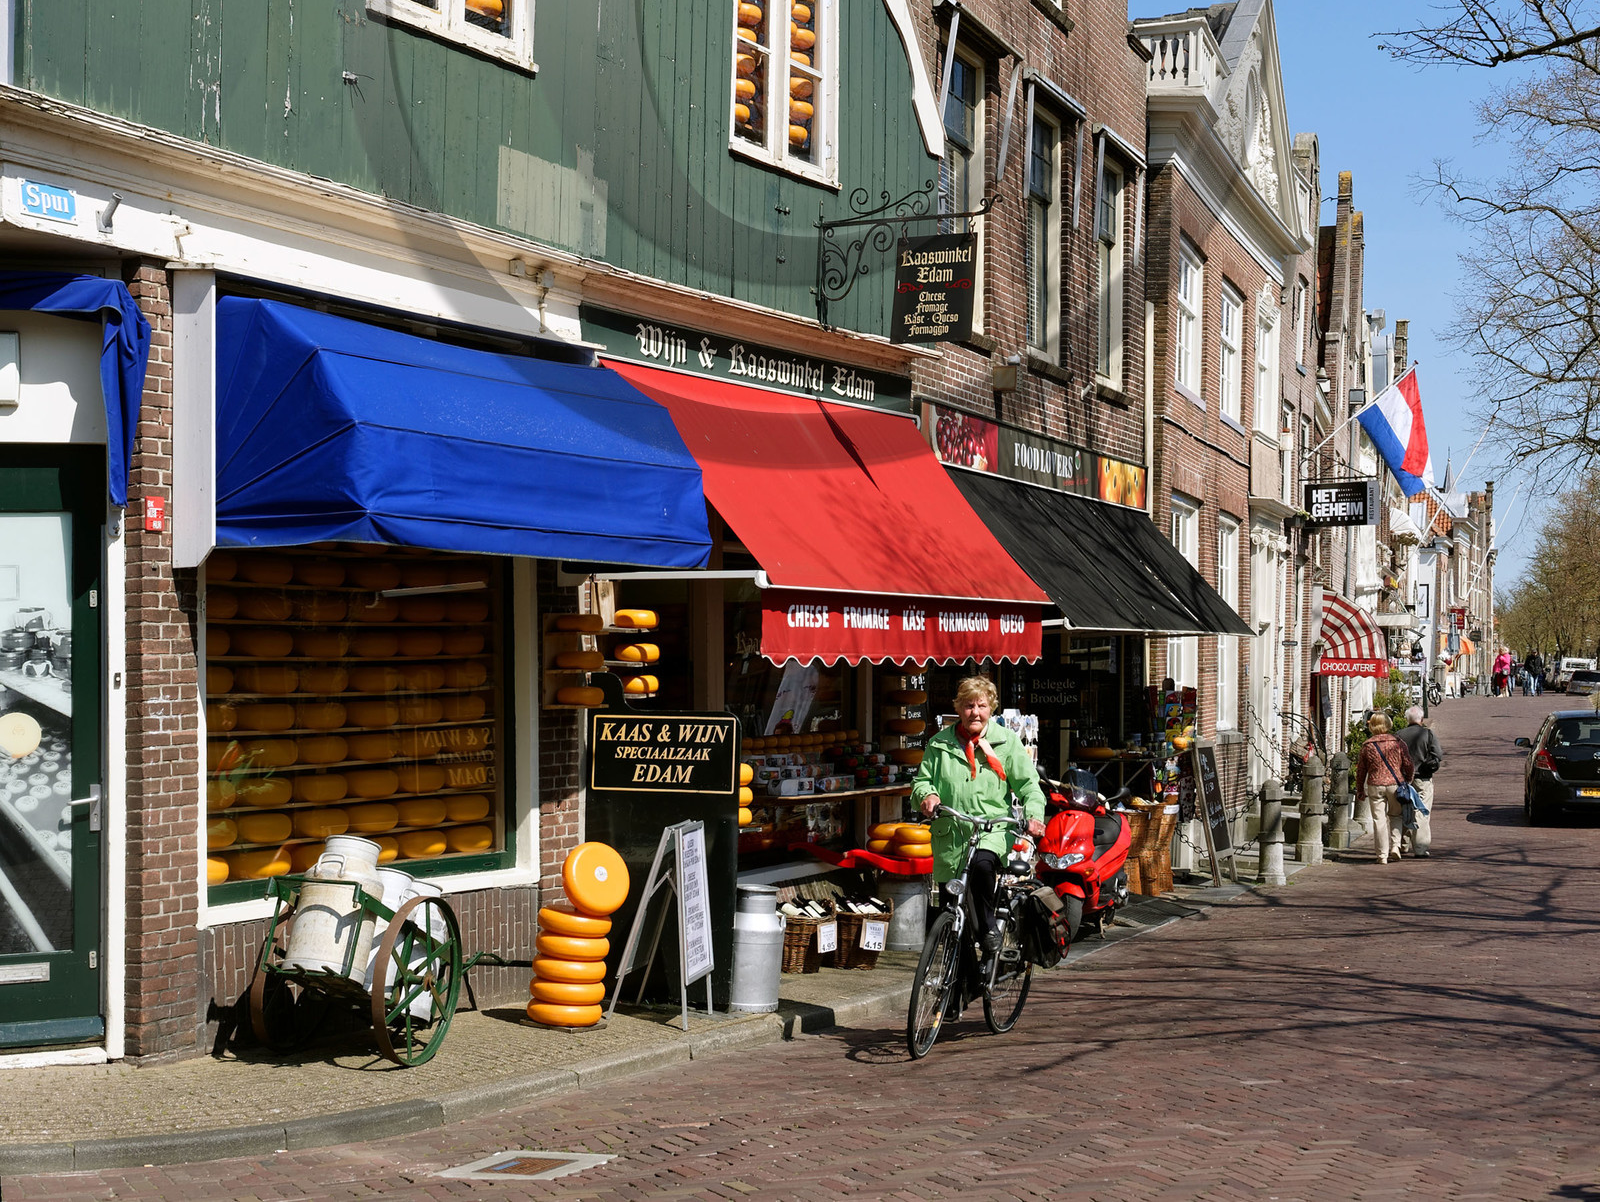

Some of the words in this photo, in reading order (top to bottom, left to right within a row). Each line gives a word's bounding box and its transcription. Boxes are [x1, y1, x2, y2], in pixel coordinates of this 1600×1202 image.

[901, 245, 972, 267] Kaaswinkel
[916, 266, 953, 283] Edam
[918, 291, 946, 302] Cheese
[931, 312, 959, 324] Queso
[635, 322, 687, 367] Wijn
[698, 335, 718, 369] &
[728, 342, 824, 392] Kaaswinkel
[831, 365, 876, 401] Edam
[1312, 488, 1339, 503] HET
[1312, 501, 1363, 517] GEHEIM
[787, 604, 830, 628] CHEESE
[843, 606, 890, 630] FROMAGE
[902, 605, 926, 631] KÄSE
[938, 611, 989, 633] FORMAGGIO
[1000, 613, 1025, 635] QUESO
[1321, 662, 1376, 672] CHOCOLATERIE
[1032, 678, 1076, 691] Belegde
[1030, 693, 1078, 705] Broodjes
[600, 722, 653, 742] KAAS
[656, 723, 672, 743] &
[678, 724, 729, 744] WIJN
[614, 746, 712, 761] SPECIAALZAAK
[632, 764, 695, 784] EDAM
[864, 941, 882, 950] 4.15
